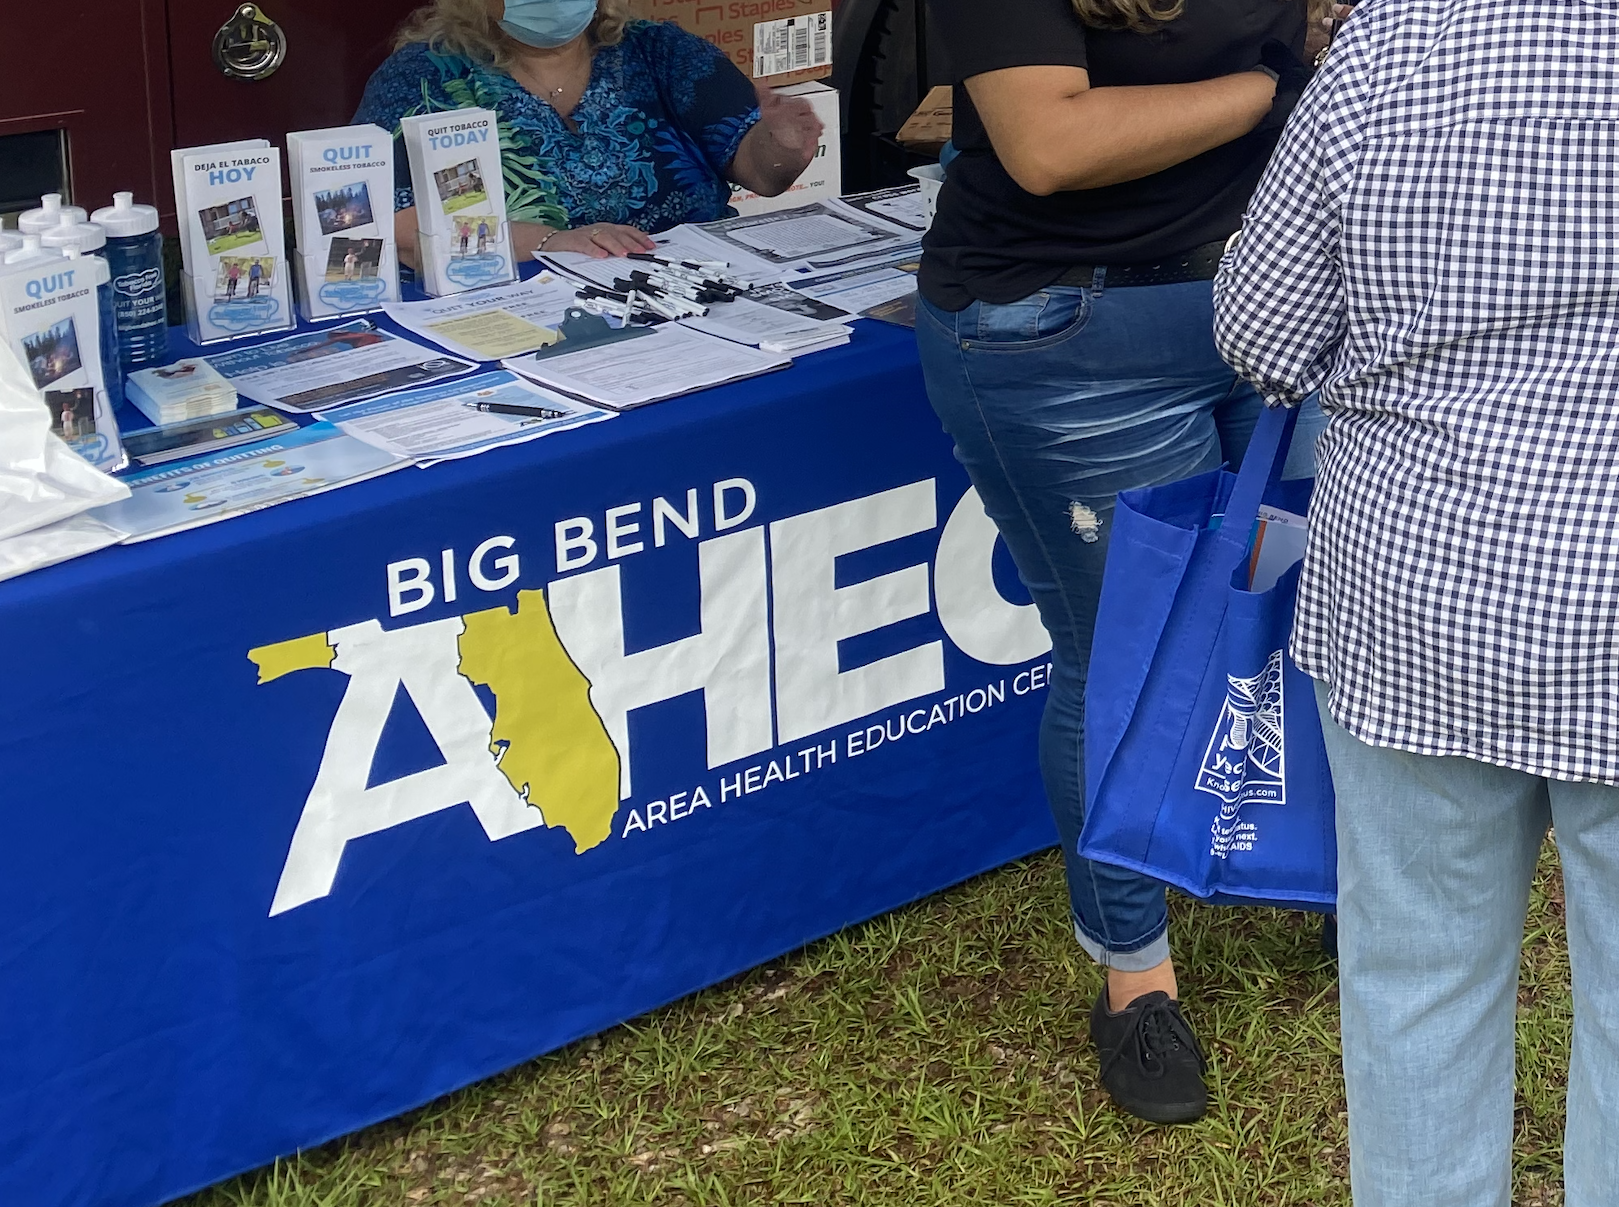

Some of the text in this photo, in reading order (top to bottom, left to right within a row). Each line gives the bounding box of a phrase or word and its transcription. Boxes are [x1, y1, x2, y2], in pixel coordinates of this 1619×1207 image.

[704, 28, 744, 44] ples
[428, 120, 489, 136] QUIT TOBACCO
[429, 128, 489, 151] TODAY
[194, 156, 270, 172] DEJA EL TABACO
[322, 145, 373, 164] QUIT
[209, 166, 257, 186] HOY
[310, 161, 386, 173] SMOKELESS TOBACCO
[25, 270, 75, 299] QUIT
[14, 288, 90, 314] SMOKELESS TOBACCO
[132, 296, 155, 307] YOUR
[432, 304, 464, 314] QUIT
[465, 296, 506, 308] YOUR
[192, 461, 213, 471] OF
[213, 443, 285, 465] QUITTING
[386, 476, 757, 617] BIG BEND
[248, 477, 1053, 917] AHEC
[622, 663, 1053, 838] AREA HEALTH EDUCATION CEN
